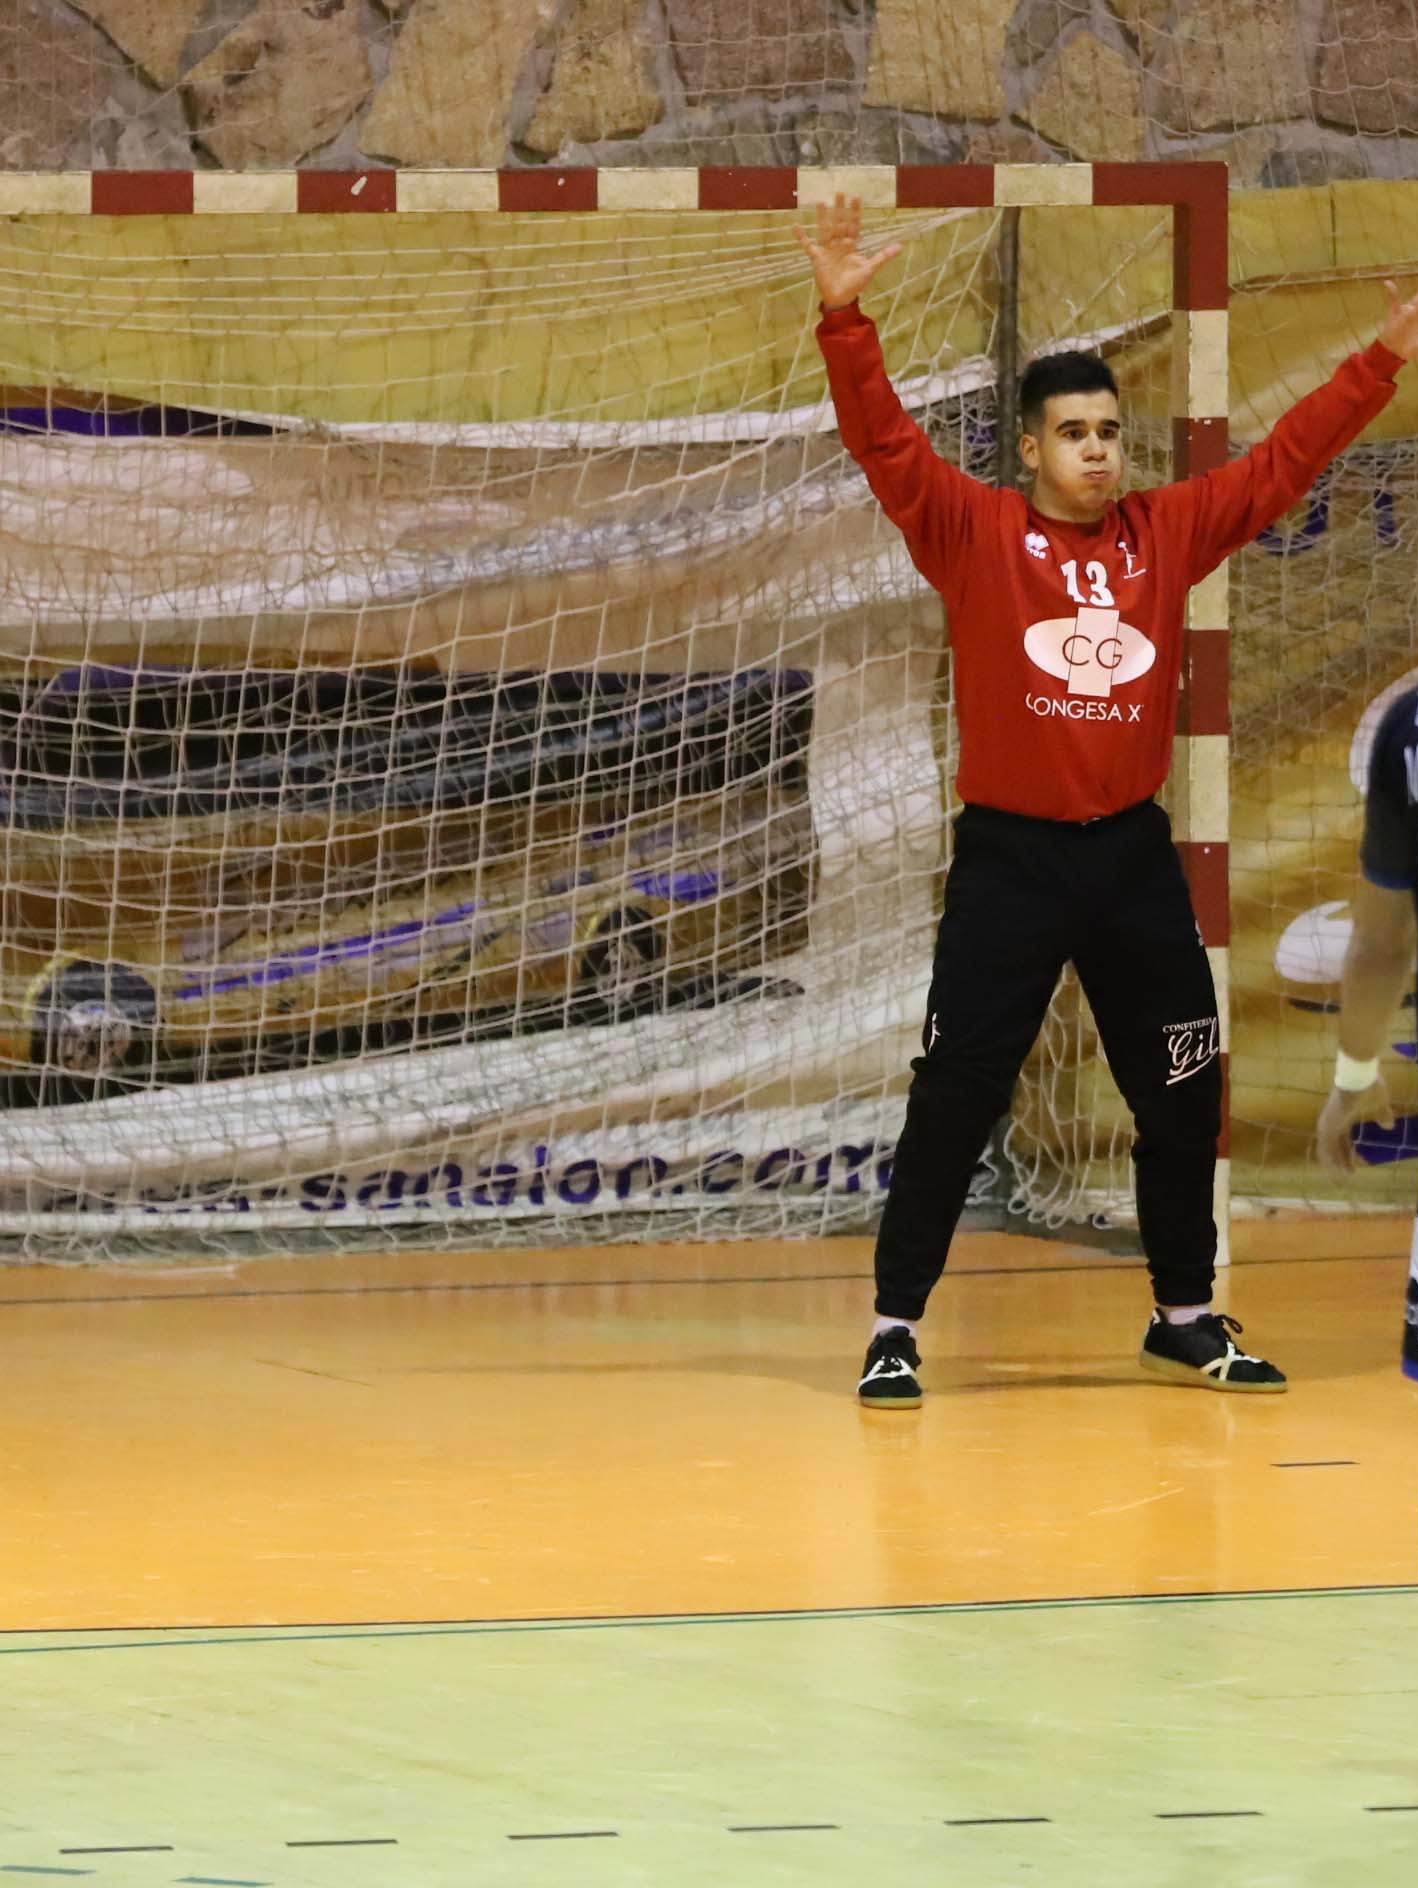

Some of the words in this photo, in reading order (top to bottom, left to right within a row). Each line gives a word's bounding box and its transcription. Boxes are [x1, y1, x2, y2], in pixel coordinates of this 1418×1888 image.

[1060, 559, 1115, 608] 13
[1062, 634, 1123, 670] CG
[1167, 1016, 1219, 1077] Gil
